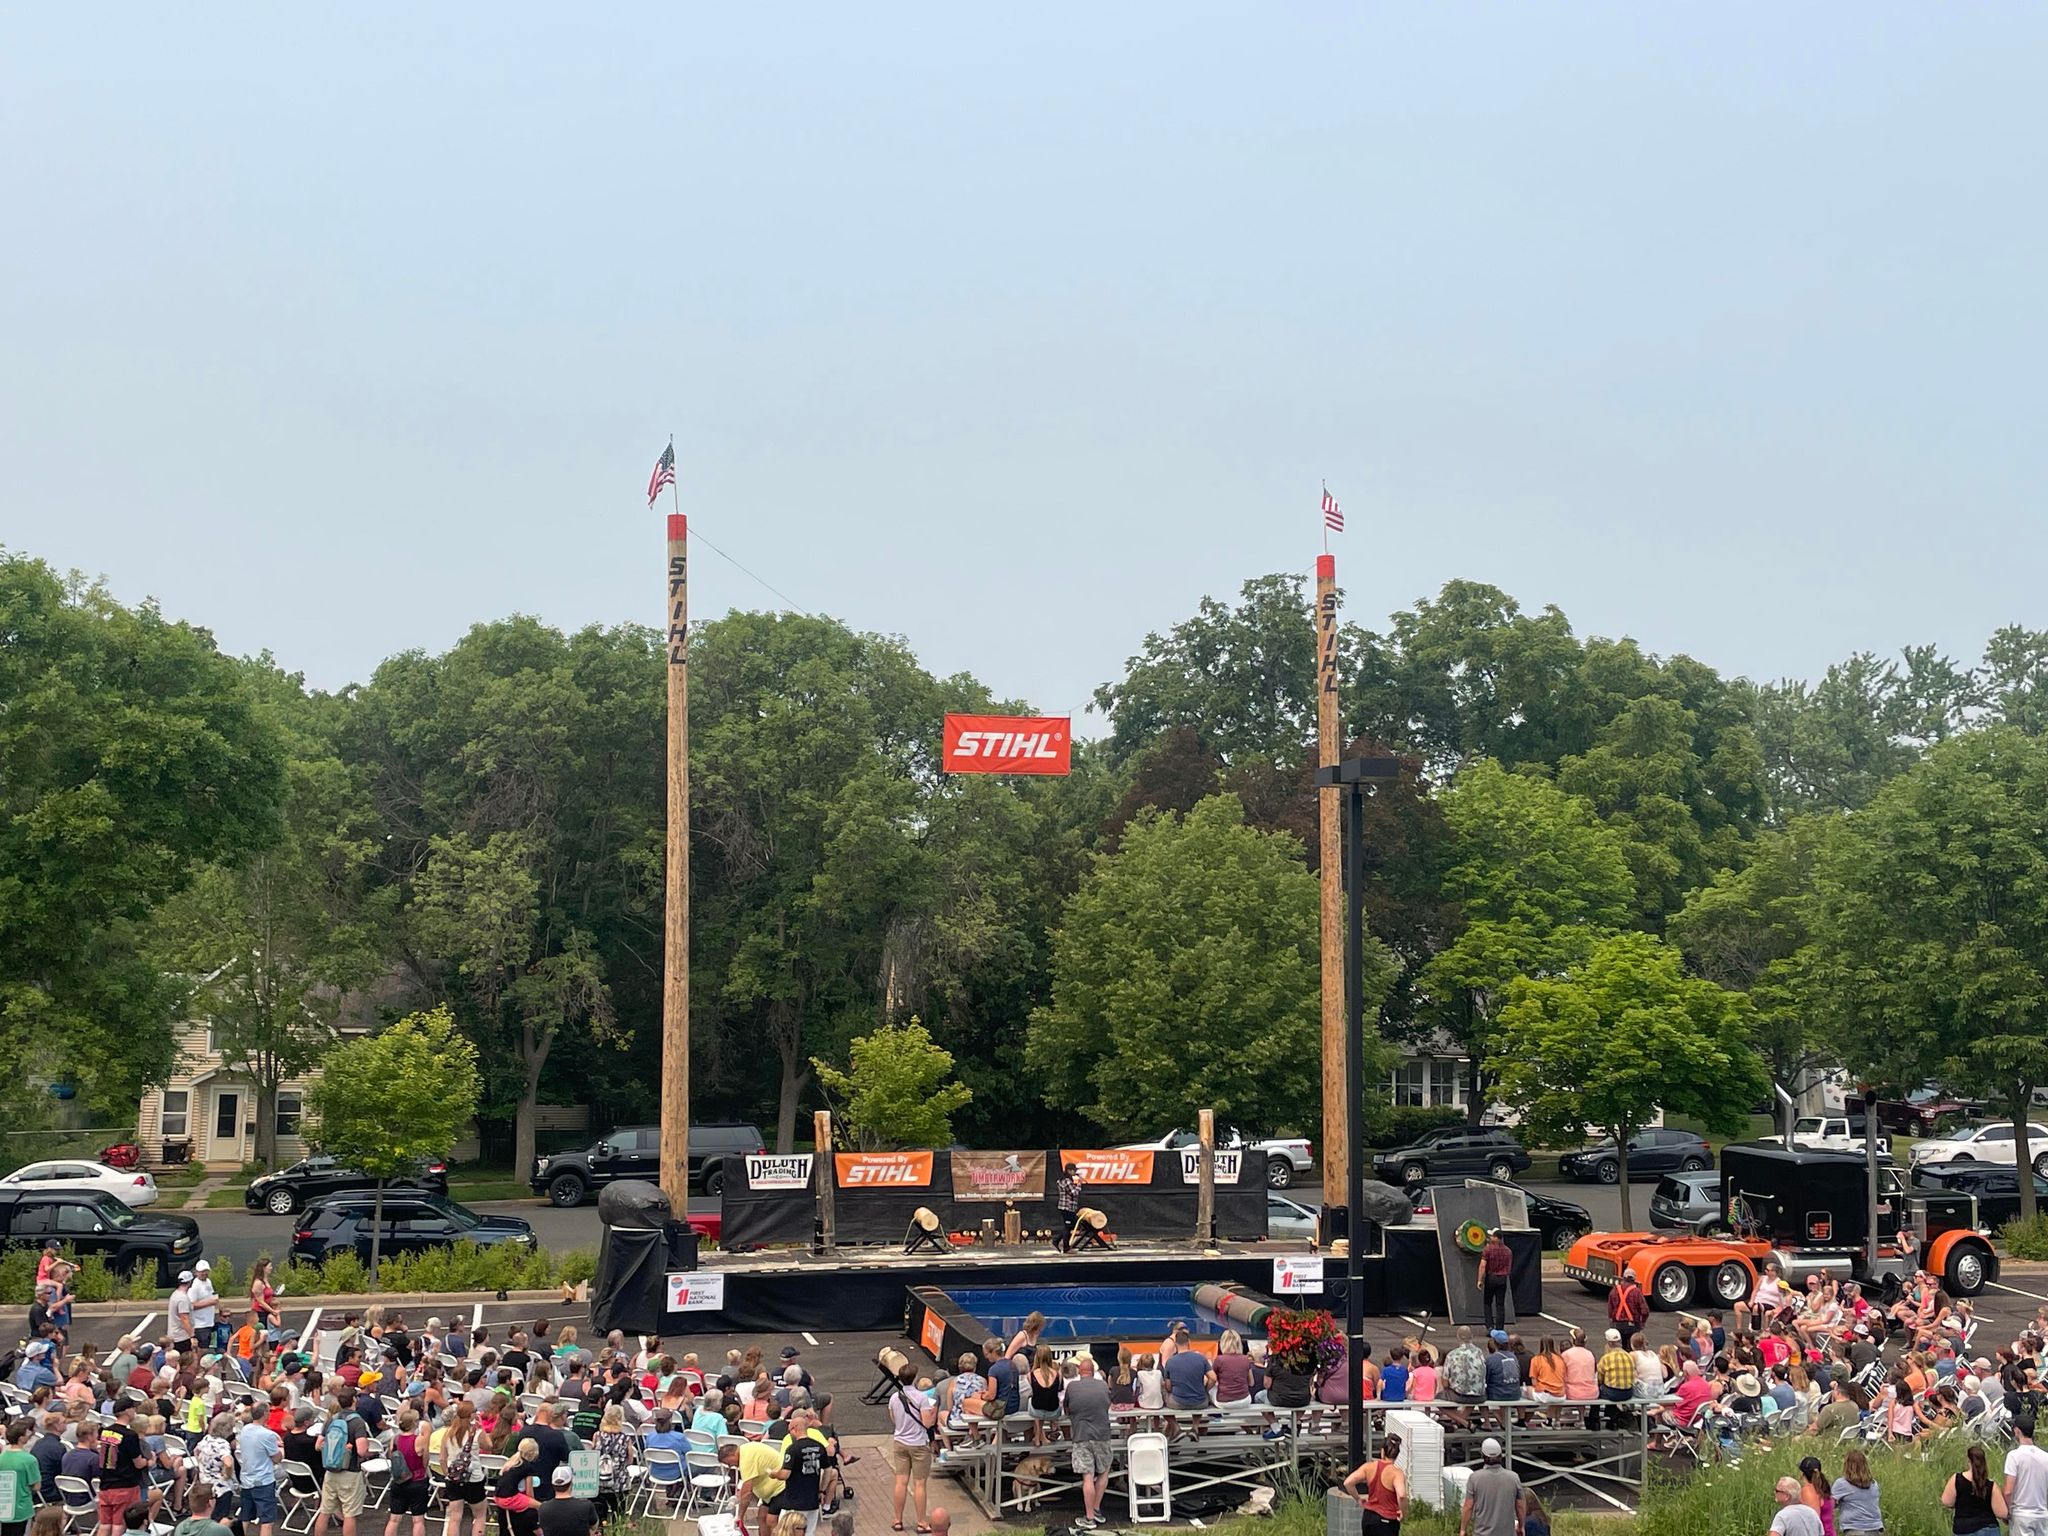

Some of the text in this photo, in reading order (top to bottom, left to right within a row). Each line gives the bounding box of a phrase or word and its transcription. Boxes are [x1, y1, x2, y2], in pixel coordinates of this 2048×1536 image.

[669, 556, 687, 665] STIHL
[1321, 593, 1338, 693] STIHL
[952, 731, 1058, 759] STIHL
[862, 1155, 909, 1165] Powered By
[1119, 1153, 1130, 1162] By
[1185, 1155, 1238, 1174] DUUTH
[750, 1159, 808, 1180] DULUTH
[762, 1168, 797, 1179] TRADING
[846, 1164, 919, 1183] STIHL
[970, 1171, 1027, 1184] TIMBERWORKS
[580, 1457, 589, 1467] 15
